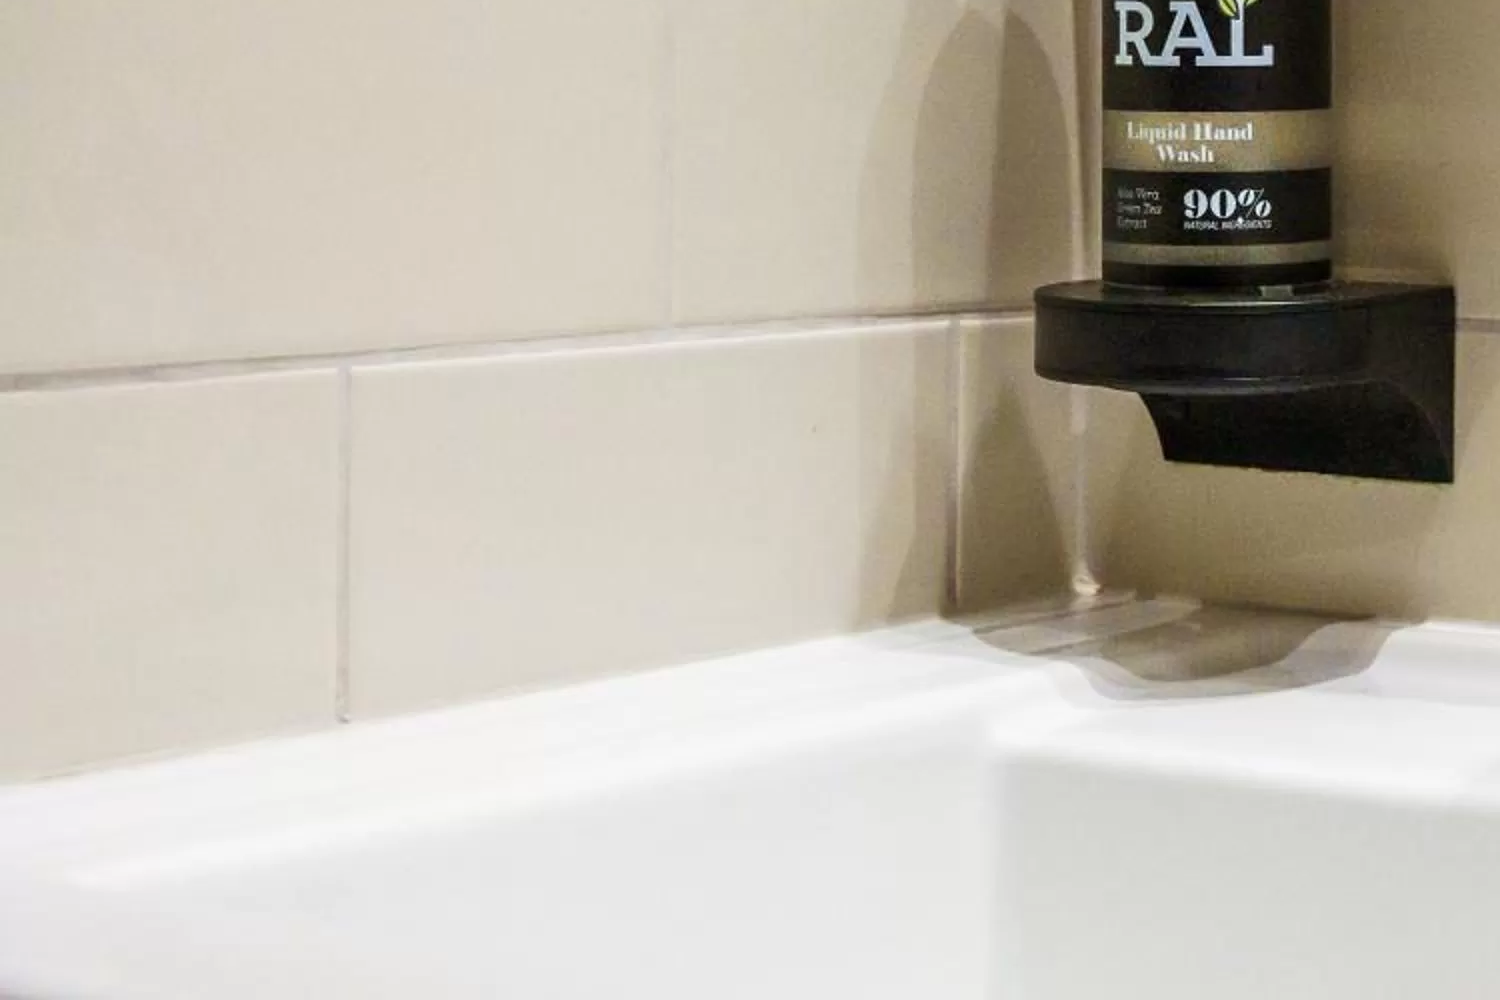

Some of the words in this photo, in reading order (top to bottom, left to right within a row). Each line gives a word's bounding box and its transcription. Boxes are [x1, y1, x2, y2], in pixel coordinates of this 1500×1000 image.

[1127, 121, 1186, 145] Liquid
[1194, 121, 1253, 141] Hand
[1157, 144, 1215, 163] Wash
[1183, 187, 1272, 219] 90%
